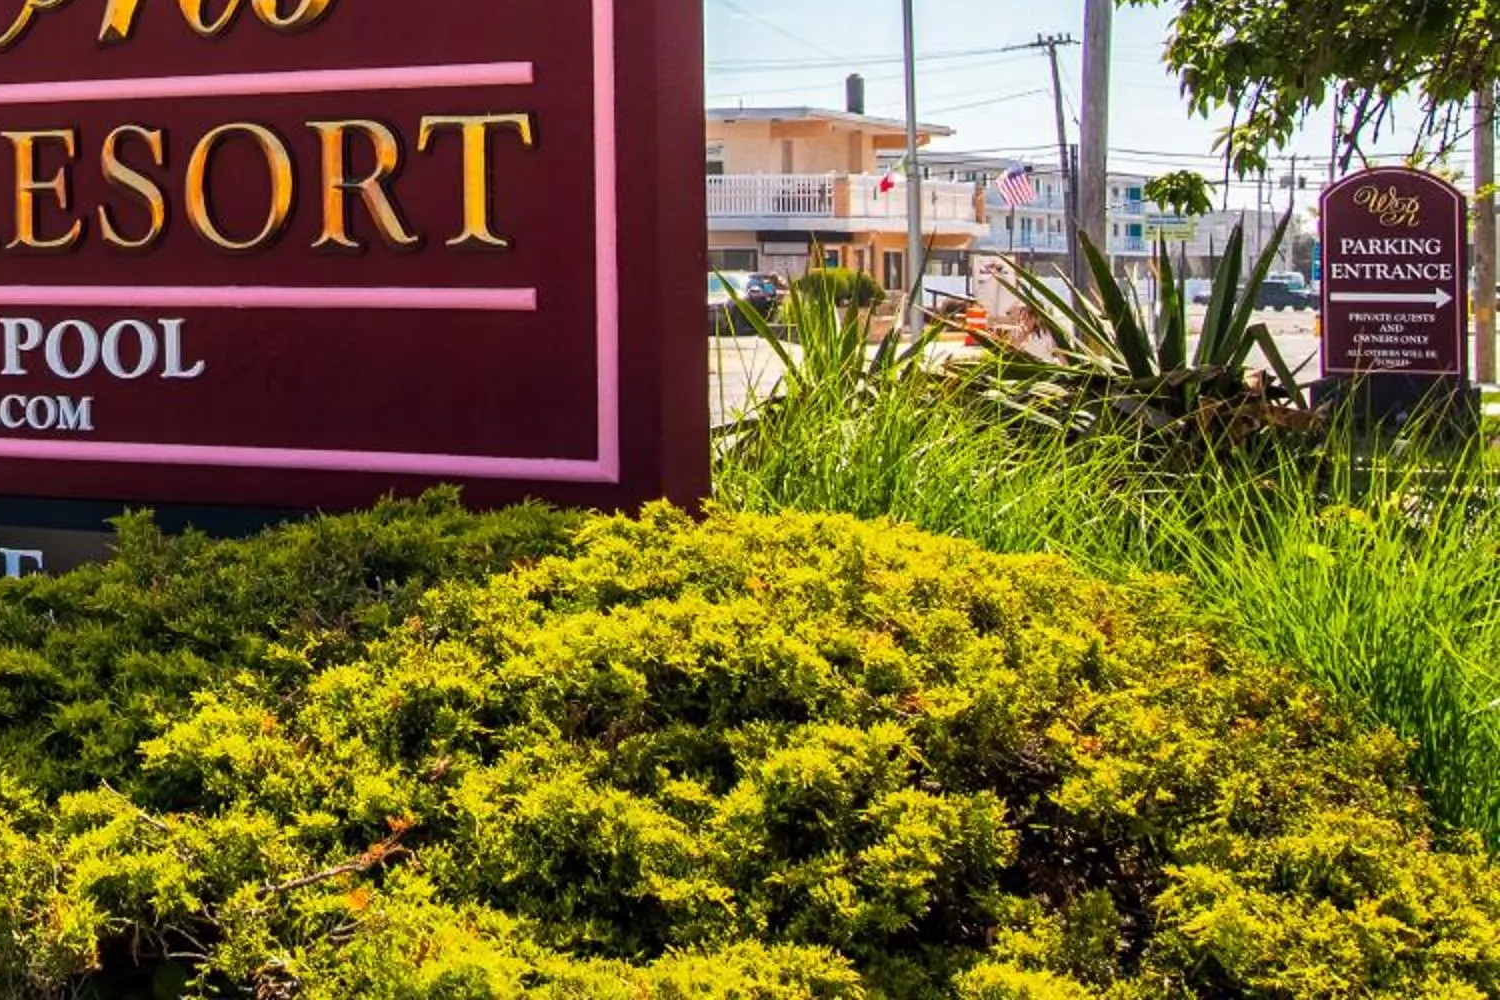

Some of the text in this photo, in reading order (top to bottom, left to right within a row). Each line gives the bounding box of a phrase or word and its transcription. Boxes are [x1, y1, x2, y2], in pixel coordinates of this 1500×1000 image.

[1341, 238, 1442, 255] PARKING
[1330, 263, 1453, 281] ENTRANCE
[1348, 313, 1436, 323] PRIVATE GUESTS
[1379, 324, 1405, 333] AND
[1353, 334, 1430, 345] OWNERS ONLY
